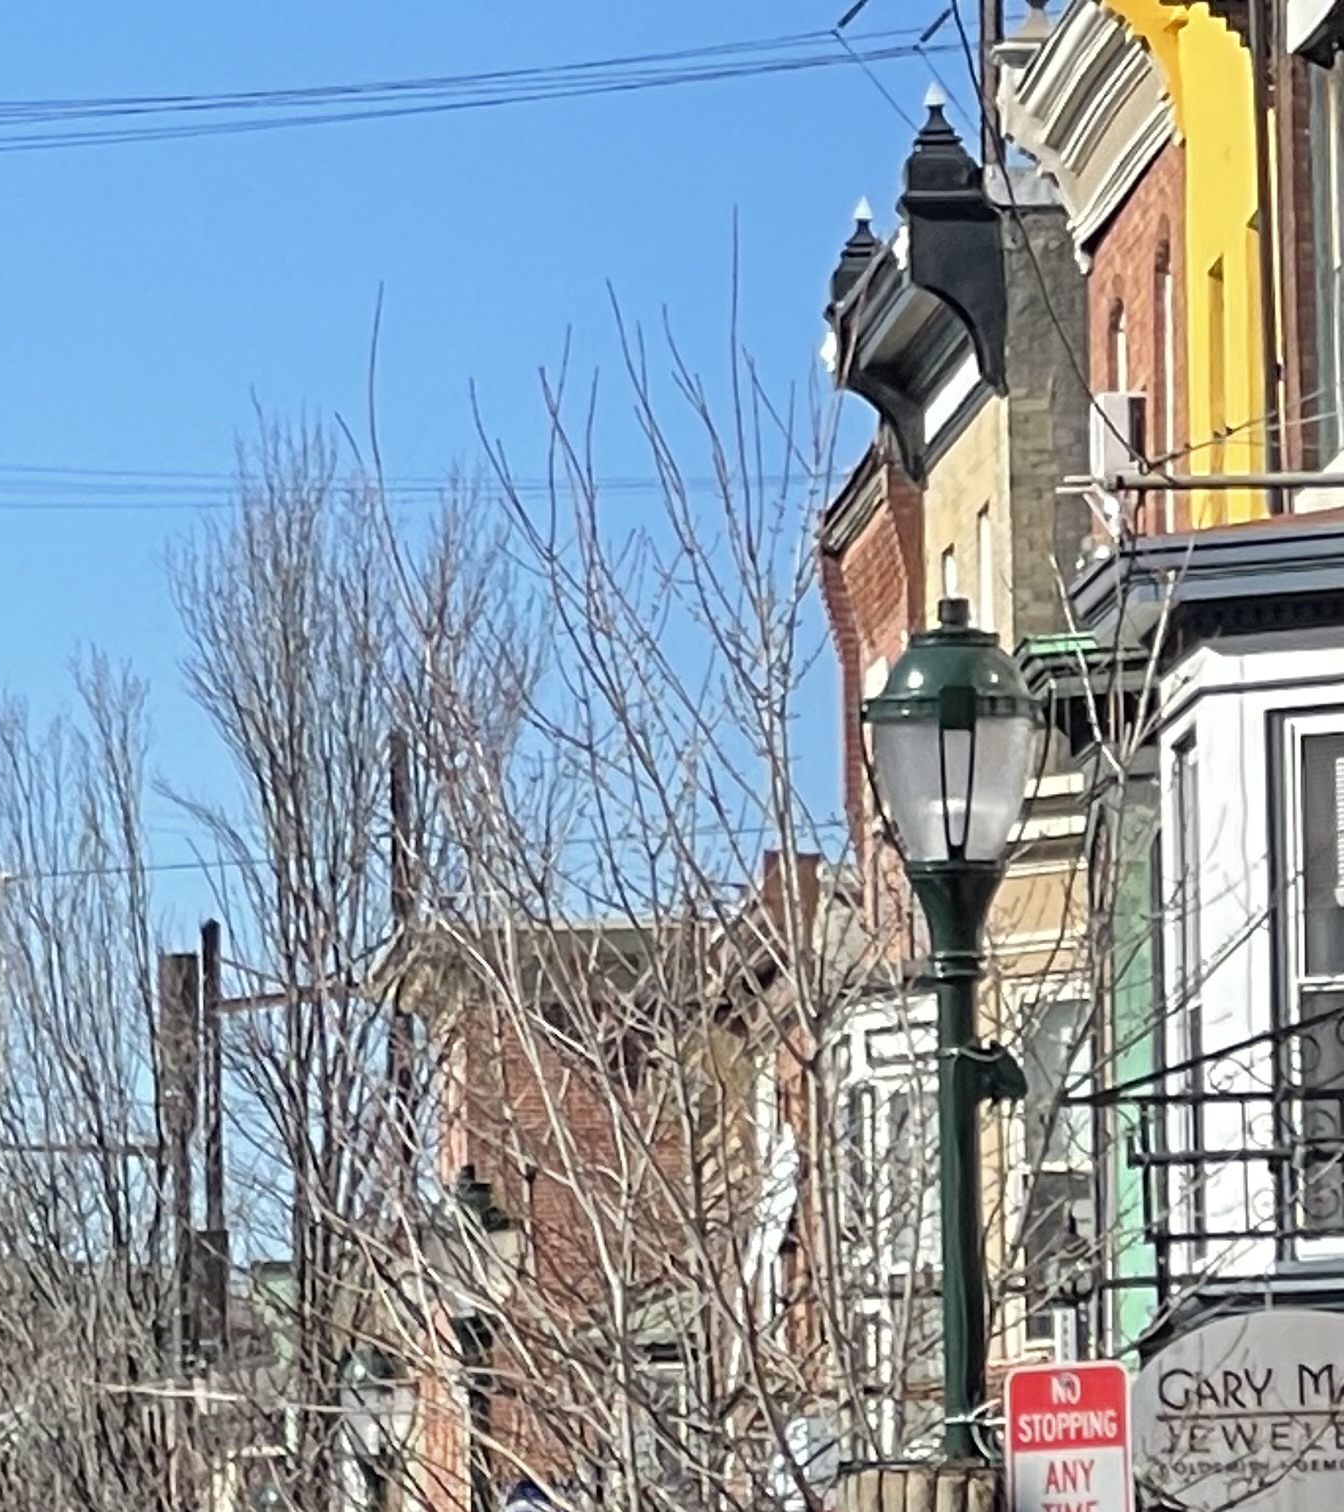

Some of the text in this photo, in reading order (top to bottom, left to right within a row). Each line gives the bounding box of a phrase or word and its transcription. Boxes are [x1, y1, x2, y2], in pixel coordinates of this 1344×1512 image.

[1049, 1374, 1081, 1405] NO
[1159, 1368, 1272, 1410] GARY
[1018, 1409, 1118, 1443] STOPPING
[1045, 1458, 1095, 1495] ANY
